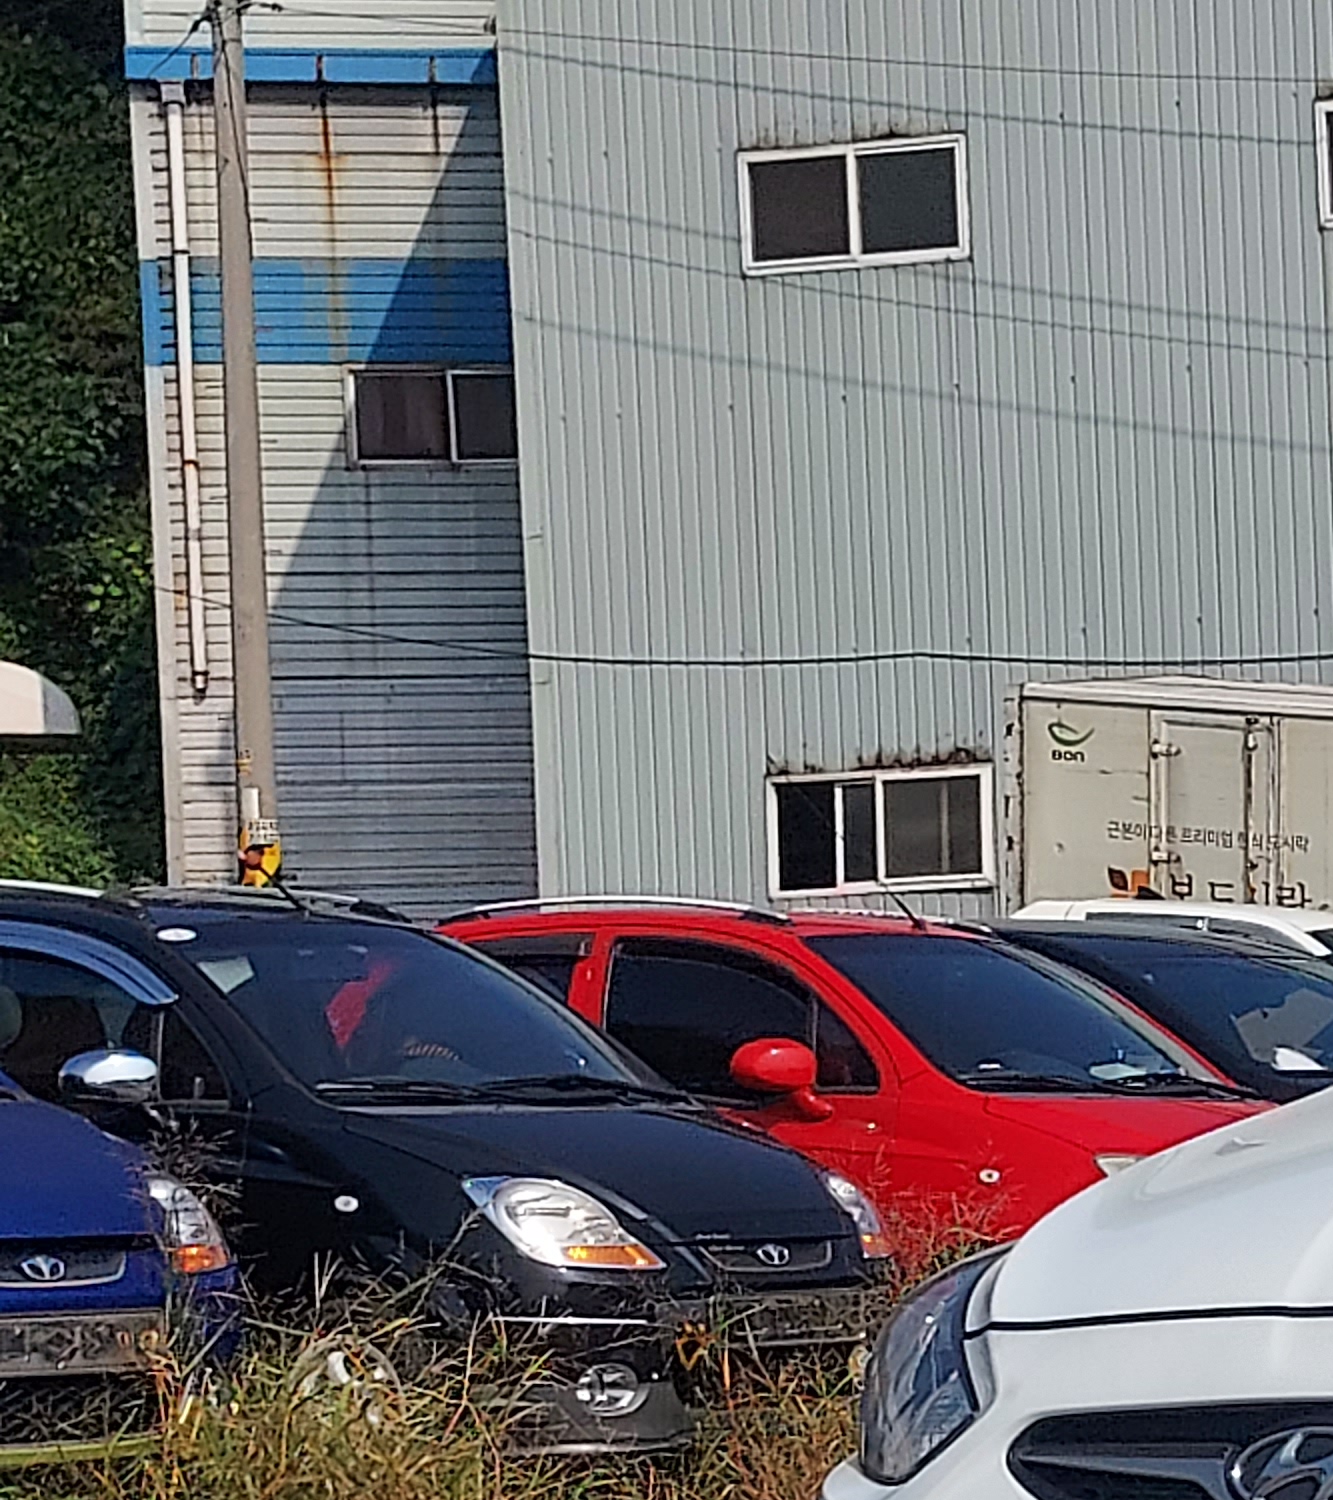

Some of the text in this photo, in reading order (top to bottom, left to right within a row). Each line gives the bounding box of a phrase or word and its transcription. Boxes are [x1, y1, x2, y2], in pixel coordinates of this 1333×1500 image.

[1107, 821, 1147, 841] 근본이
[1148, 824, 1178, 843] 다른
[1179, 827, 1233, 849] 프리미엄
